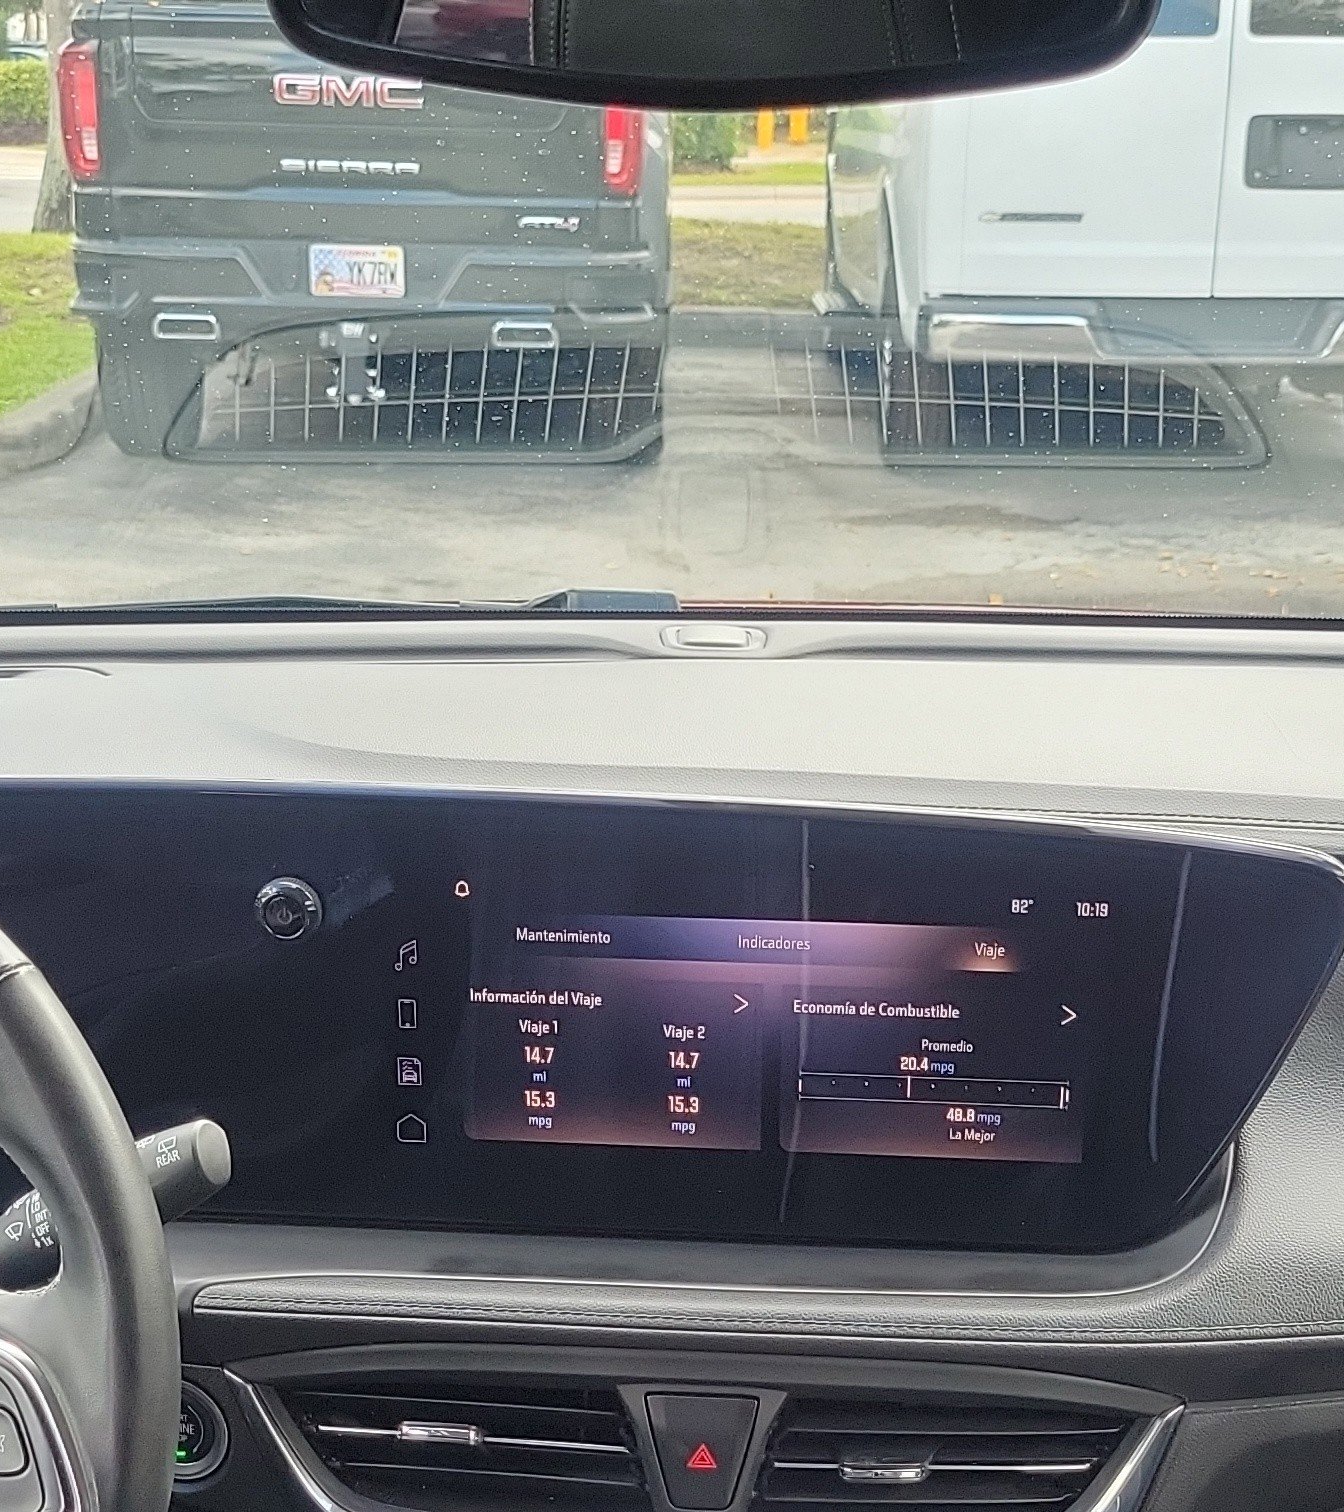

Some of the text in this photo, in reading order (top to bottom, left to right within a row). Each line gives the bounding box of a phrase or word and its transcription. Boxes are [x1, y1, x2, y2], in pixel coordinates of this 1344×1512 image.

[273, 73, 424, 109] GMC
[1076, 901, 1109, 917] 10:19
[516, 927, 611, 944] Mantenimiento
[738, 935, 811, 950] Indicadores
[975, 942, 1006, 959] Viaje
[470, 988, 603, 1010] Información del Viaje
[793, 1000, 960, 1019] Economía de Combustible
[519, 1019, 558, 1037] Viaje 1
[663, 1024, 706, 1042] Viaje 2
[921, 1039, 974, 1053] Promedio
[524, 1046, 554, 1064] 14.7
[669, 1051, 700, 1069] 14.7
[900, 1057, 955, 1075] 20.4 mpg
[532, 1070, 547, 1082] mi
[676, 1076, 691, 1088] mi
[524, 1090, 555, 1108] 15.3
[668, 1095, 699, 1113] 15.3
[528, 1116, 553, 1129] mpg
[671, 1121, 696, 1134] mpg
[977, 1113, 1001, 1126] mpg
[949, 1128, 996, 1144] La Mejor
[155, 1149, 181, 1168] REAR
[31, 1201, 41, 1213] LO
[35, 1221, 51, 1237] OFF
